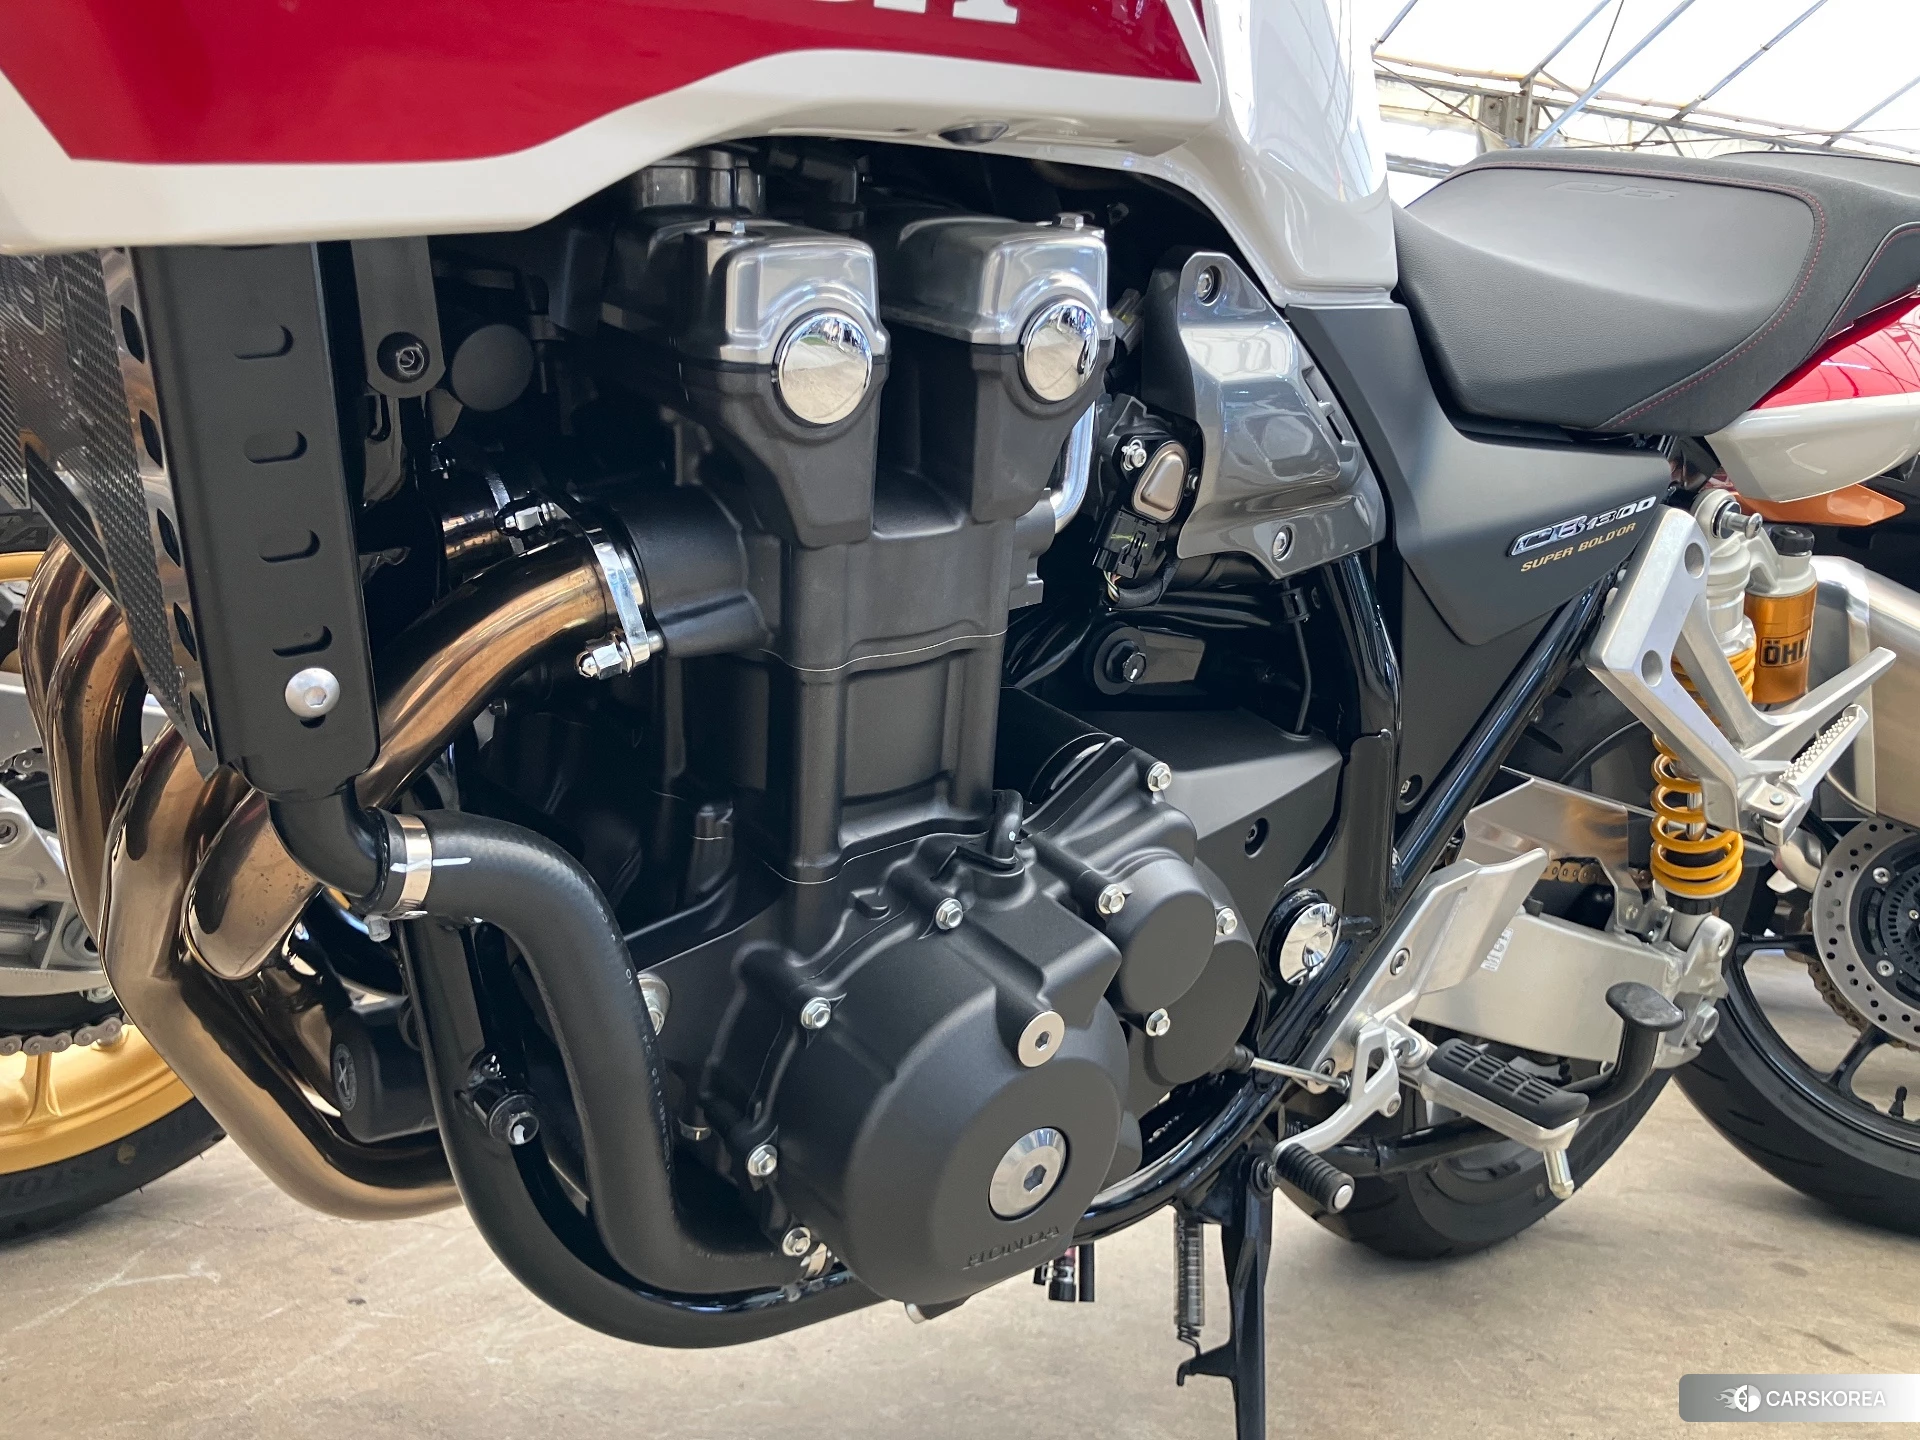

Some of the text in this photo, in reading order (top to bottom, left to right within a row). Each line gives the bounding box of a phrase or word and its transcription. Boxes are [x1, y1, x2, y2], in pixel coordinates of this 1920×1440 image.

[1520, 522, 1637, 573] SUPER BOLD'OR
[962, 1225, 1060, 1270] HONDA
